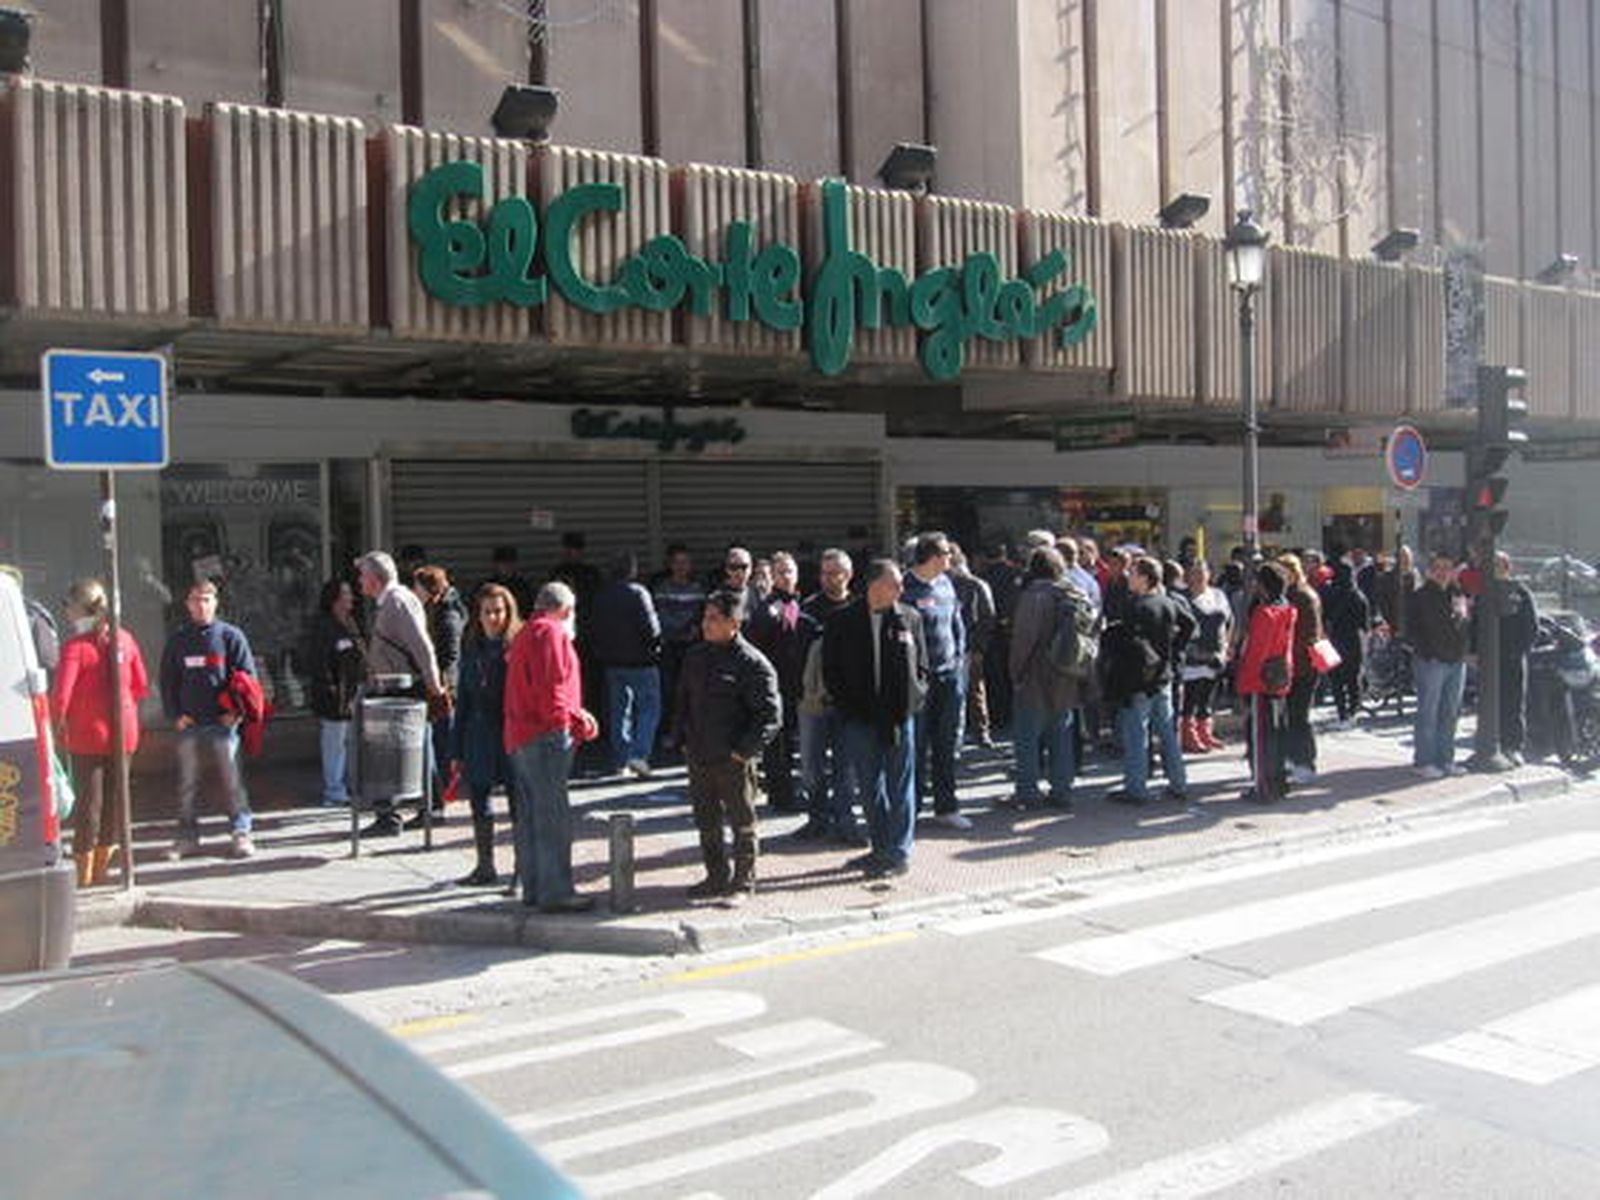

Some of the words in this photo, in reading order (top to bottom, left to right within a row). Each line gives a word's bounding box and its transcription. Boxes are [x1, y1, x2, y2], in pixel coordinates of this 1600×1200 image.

[409, 159, 546, 308] El
[544, 182, 803, 330] Corte
[811, 178, 1098, 380] Inglés
[53, 391, 160, 428] TAXI
[172, 478, 307, 505] WELCOME
